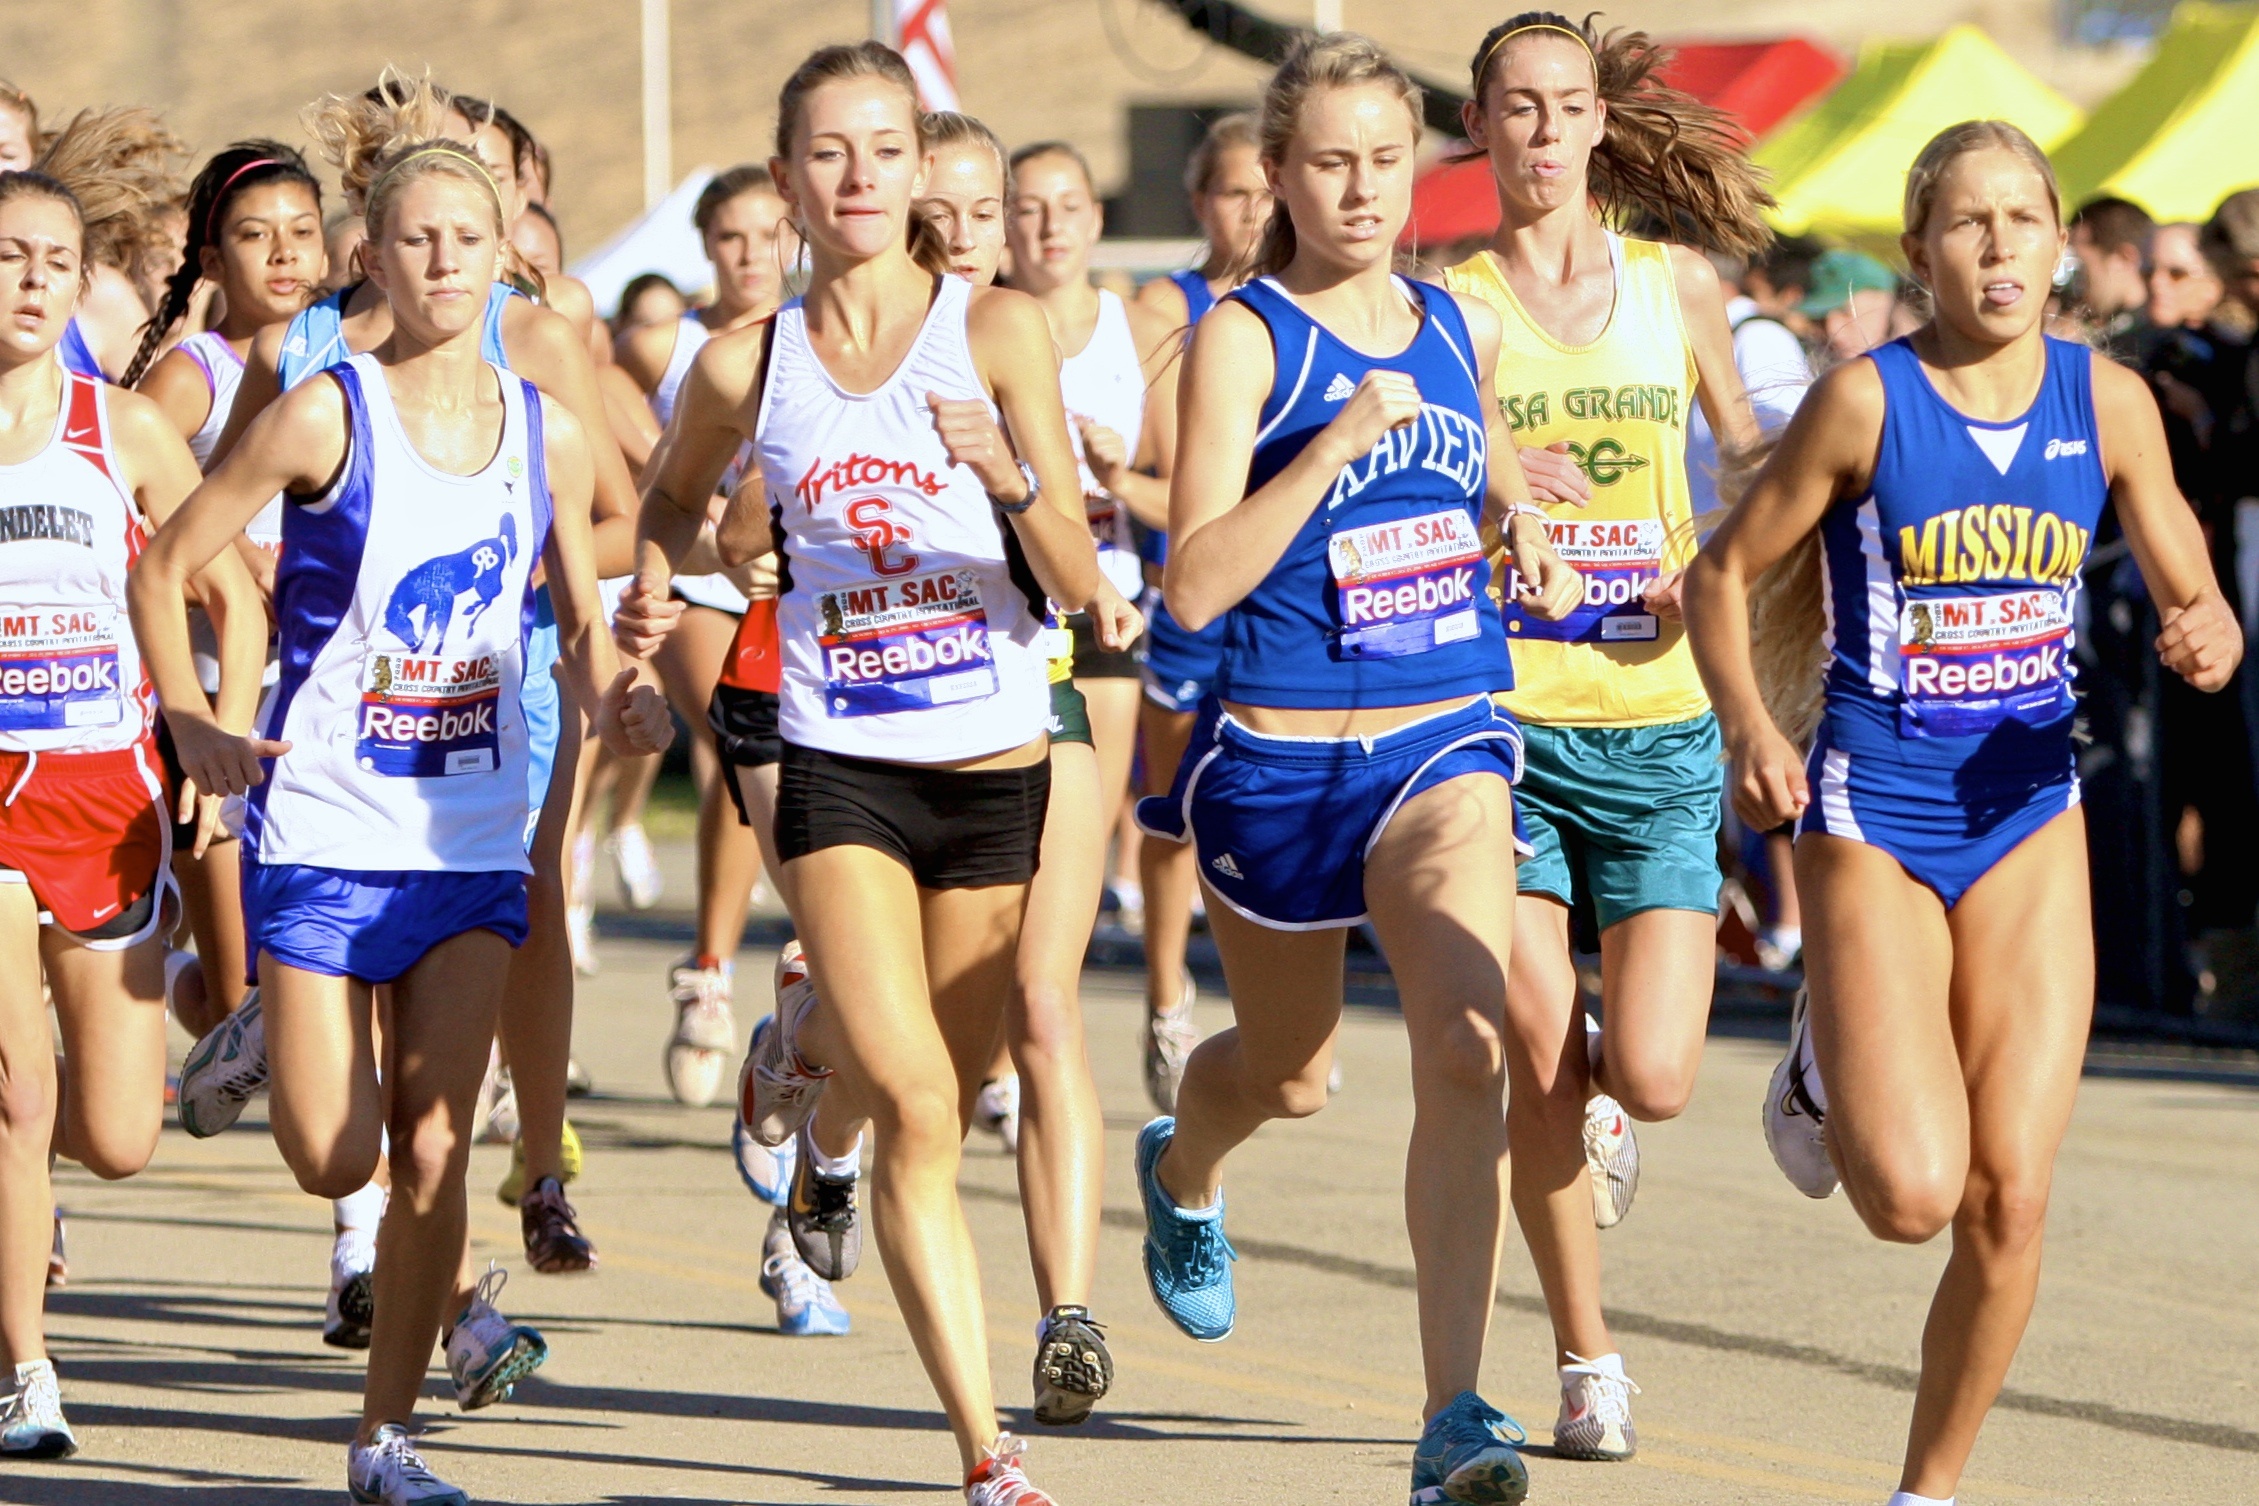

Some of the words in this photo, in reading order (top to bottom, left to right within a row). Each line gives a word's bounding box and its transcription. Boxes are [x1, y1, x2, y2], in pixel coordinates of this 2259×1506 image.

[795, 453, 949, 516] Tritons
[844, 495, 919, 579] SC
[1414, 517, 1457, 547] SAC
[1590, 524, 1639, 547] SAC
[1899, 504, 2090, 586] MISSION
[900, 575, 958, 607] SAC
[1347, 567, 1473, 625] Reebok
[2000, 594, 2046, 624] SAC
[52, 612, 97, 635] SAC
[845, 616, 872, 628] CROSS
[1935, 631, 1965, 640] CROSS
[450, 656, 491, 684] SAC
[827, 627, 991, 681] Reebok
[1908, 645, 2060, 695] Reebok
[0, 656, 117, 697] eebok
[359, 702, 495, 743] Reebok
